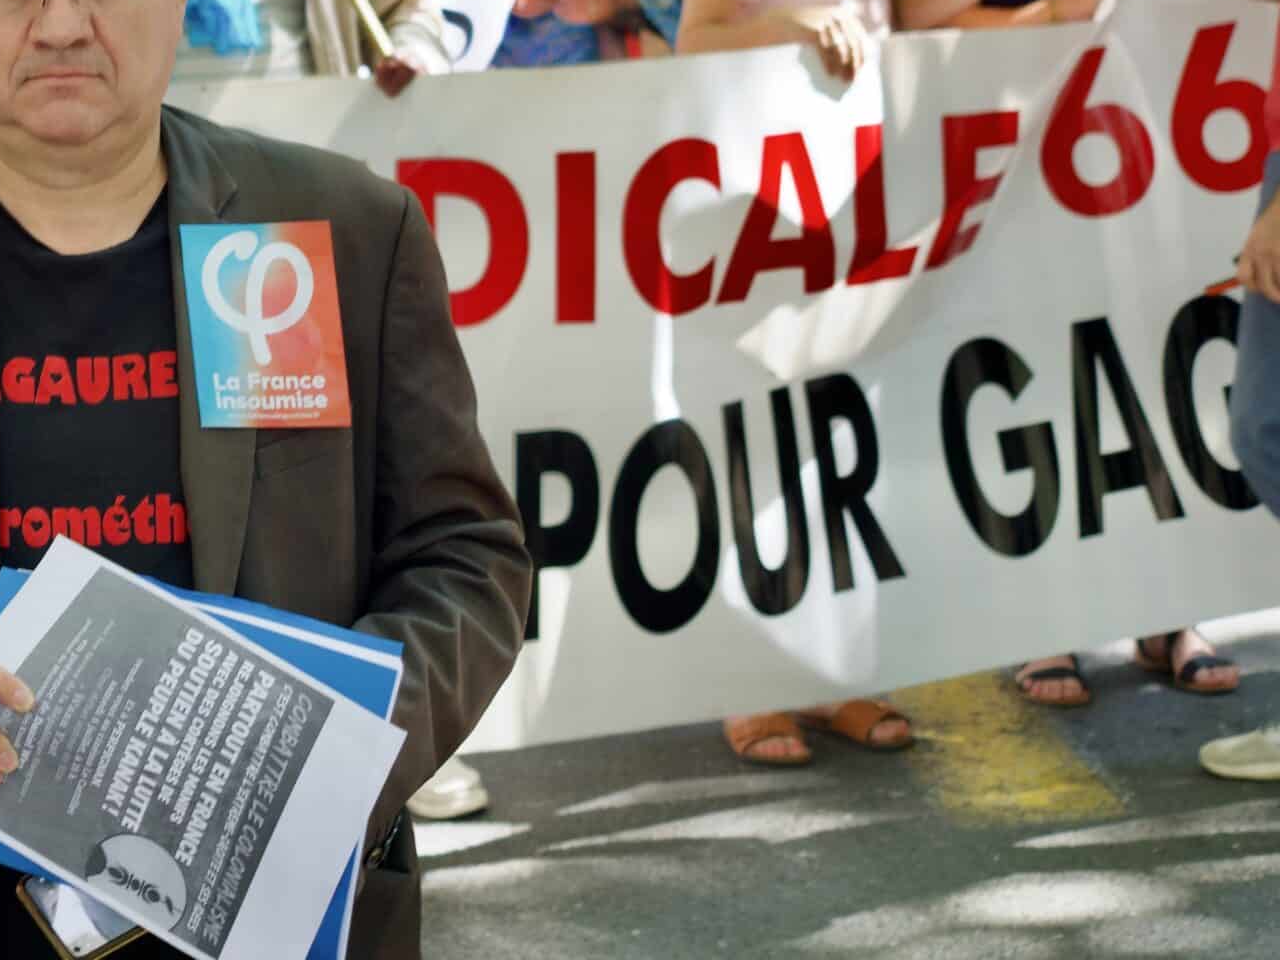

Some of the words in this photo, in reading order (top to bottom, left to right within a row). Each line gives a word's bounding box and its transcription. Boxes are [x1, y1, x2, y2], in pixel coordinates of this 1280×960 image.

[1040, 20, 1271, 218] 66
[213, 371, 240, 391] La
[247, 371, 326, 391] France
[515, 371, 906, 642] POUR
[176, 626, 203, 660] DU
[211, 649, 239, 689] AVEC
[134, 656, 186, 738] PEUPLE
[164, 637, 224, 731] SOUTIEN
[197, 687, 219, 718] DES
[203, 659, 254, 749] REJOIGNONS
[155, 726, 181, 749] À
[219, 669, 276, 764] PARTOUT
[143, 745, 169, 777] LA
[191, 746, 211, 775] LES
[257, 692, 314, 803] COMBATTRE
[120, 773, 158, 833] LUTTE
[157, 783, 174, 805] DE
[169, 772, 199, 824] MANIFS
[204, 760, 231, 794] EN
[173, 791, 216, 866] FRANCE
[246, 798, 267, 829] LE
[201, 823, 257, 946] COLONIALISME
